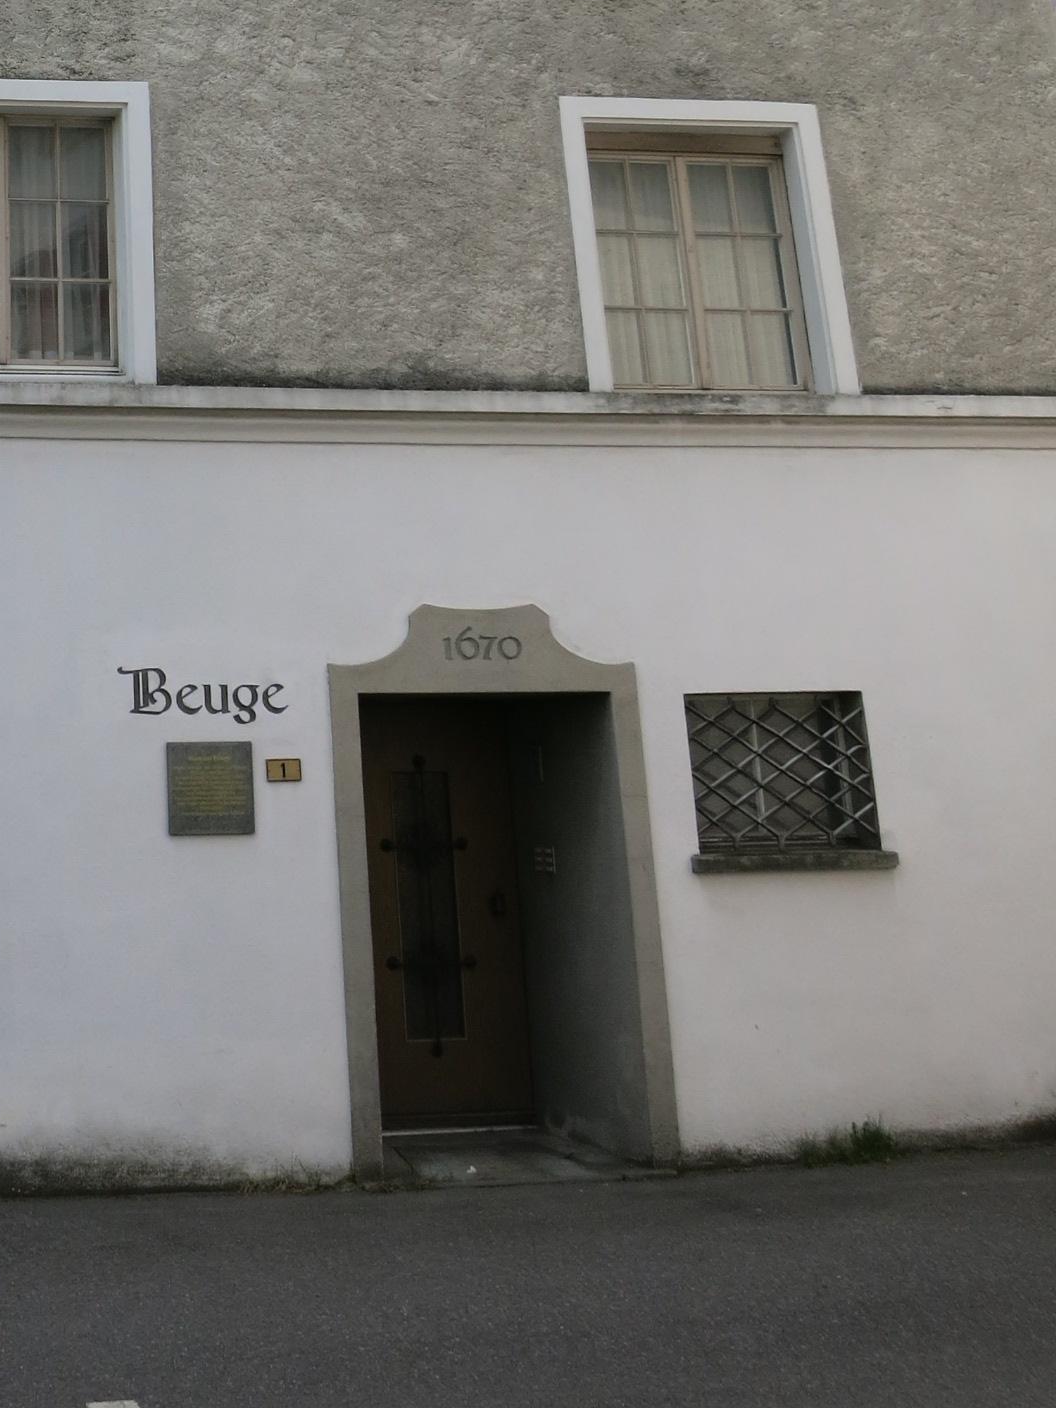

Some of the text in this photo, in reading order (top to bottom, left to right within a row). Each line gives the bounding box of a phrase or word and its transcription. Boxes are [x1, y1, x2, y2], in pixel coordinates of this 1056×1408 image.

[441, 626, 522, 661] 1670
[116, 666, 289, 725] Beuge
[280, 762, 287, 779] 1
